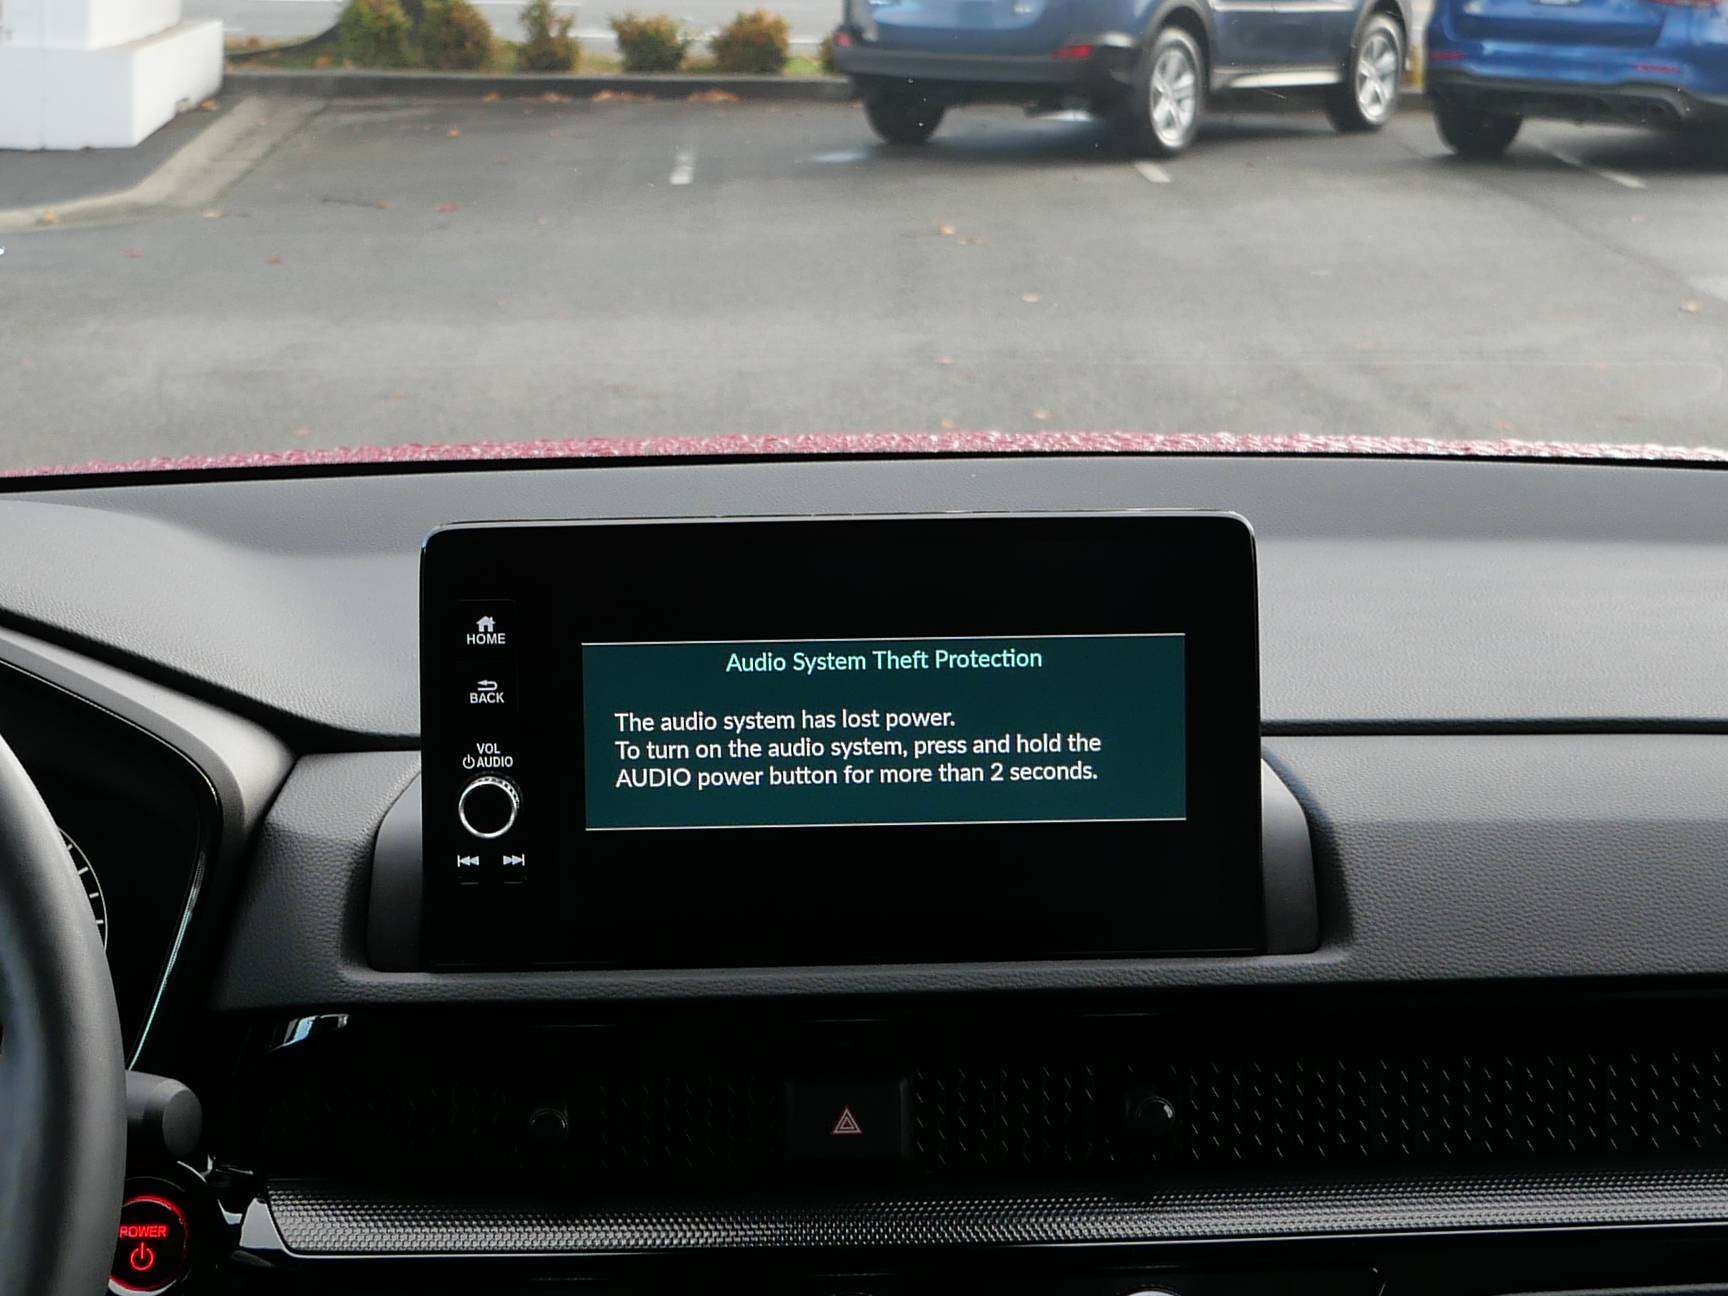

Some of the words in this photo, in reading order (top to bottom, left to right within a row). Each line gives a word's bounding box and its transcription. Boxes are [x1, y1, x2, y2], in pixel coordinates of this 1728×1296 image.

[466, 633, 506, 645] HOME
[726, 652, 786, 672] Audio
[793, 652, 866, 676] System
[872, 649, 929, 670] Theft
[936, 647, 1042, 669] Protection
[469, 692, 505, 704] BACK
[614, 712, 655, 732] The
[661, 711, 718, 731] audio
[723, 710, 795, 734] system
[802, 709, 836, 729] has
[843, 708, 880, 728] lost
[886, 711, 955, 732] power.
[476, 743, 501, 754] VOL
[614, 740, 640, 760] To
[646, 740, 690, 759] turn
[695, 744, 722, 759] on
[728, 738, 762, 757] the
[768, 737, 825, 757] audio
[831, 737, 908, 760] system,
[914, 738, 968, 760] press
[973, 734, 1010, 754] and
[1016, 733, 1061, 753] hold
[1067, 733, 1102, 753] the
[477, 756, 514, 768] AUDIO
[615, 767, 692, 788] AUDIO
[698, 770, 764, 790] power
[769, 765, 838, 785] button
[844, 764, 875, 784] for
[880, 767, 933, 784] more
[939, 762, 984, 782] than
[990, 762, 1004, 782] 2
[1009, 761, 1098, 781] seconds.
[119, 1224, 168, 1239] POWER
